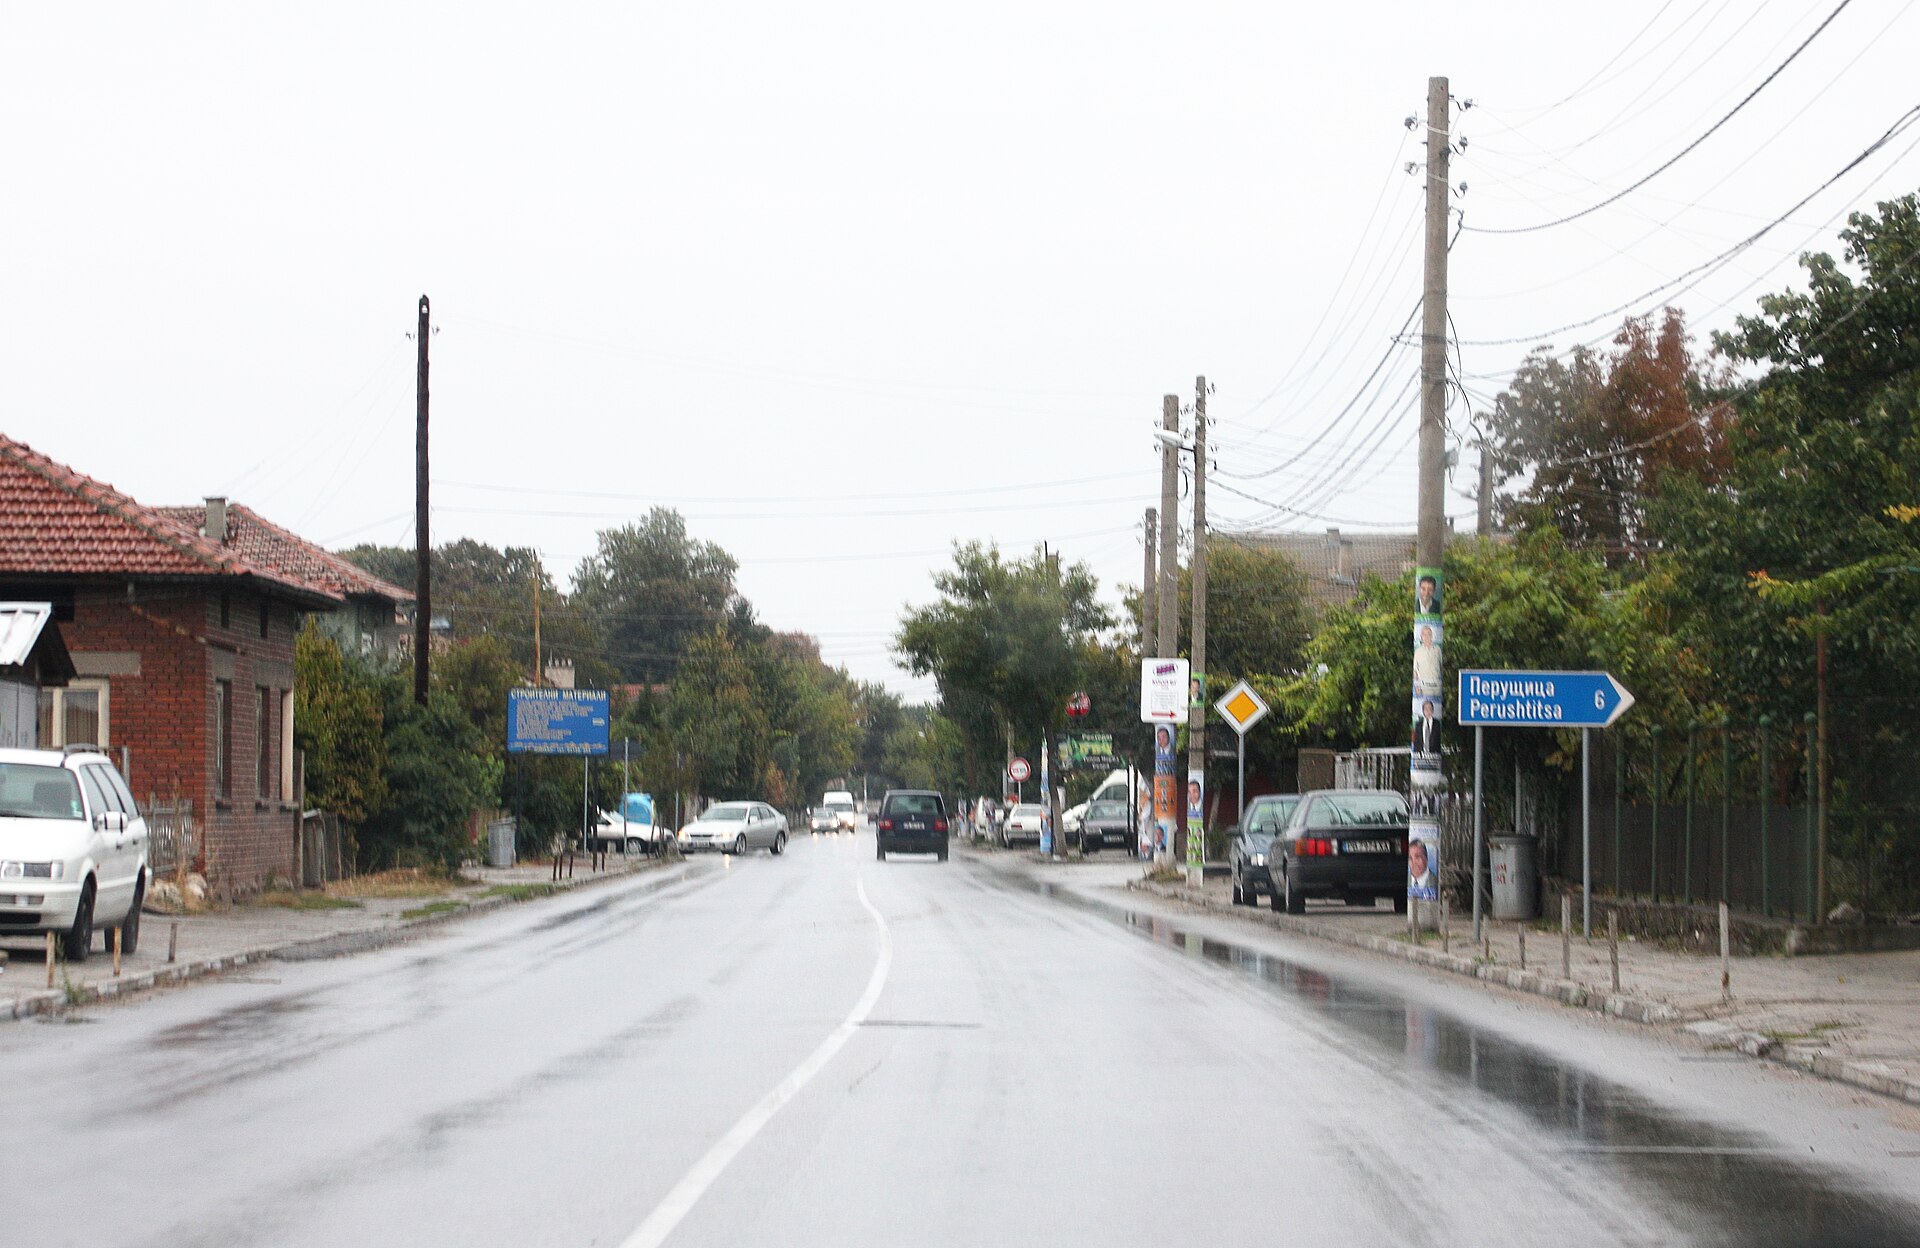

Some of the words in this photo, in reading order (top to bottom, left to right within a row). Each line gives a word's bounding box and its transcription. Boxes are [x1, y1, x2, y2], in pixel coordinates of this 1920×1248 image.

[1470, 675, 1555, 699] Перущица
[1470, 699, 1562, 720] Perushtitsa
[1594, 690, 1605, 710] 6
